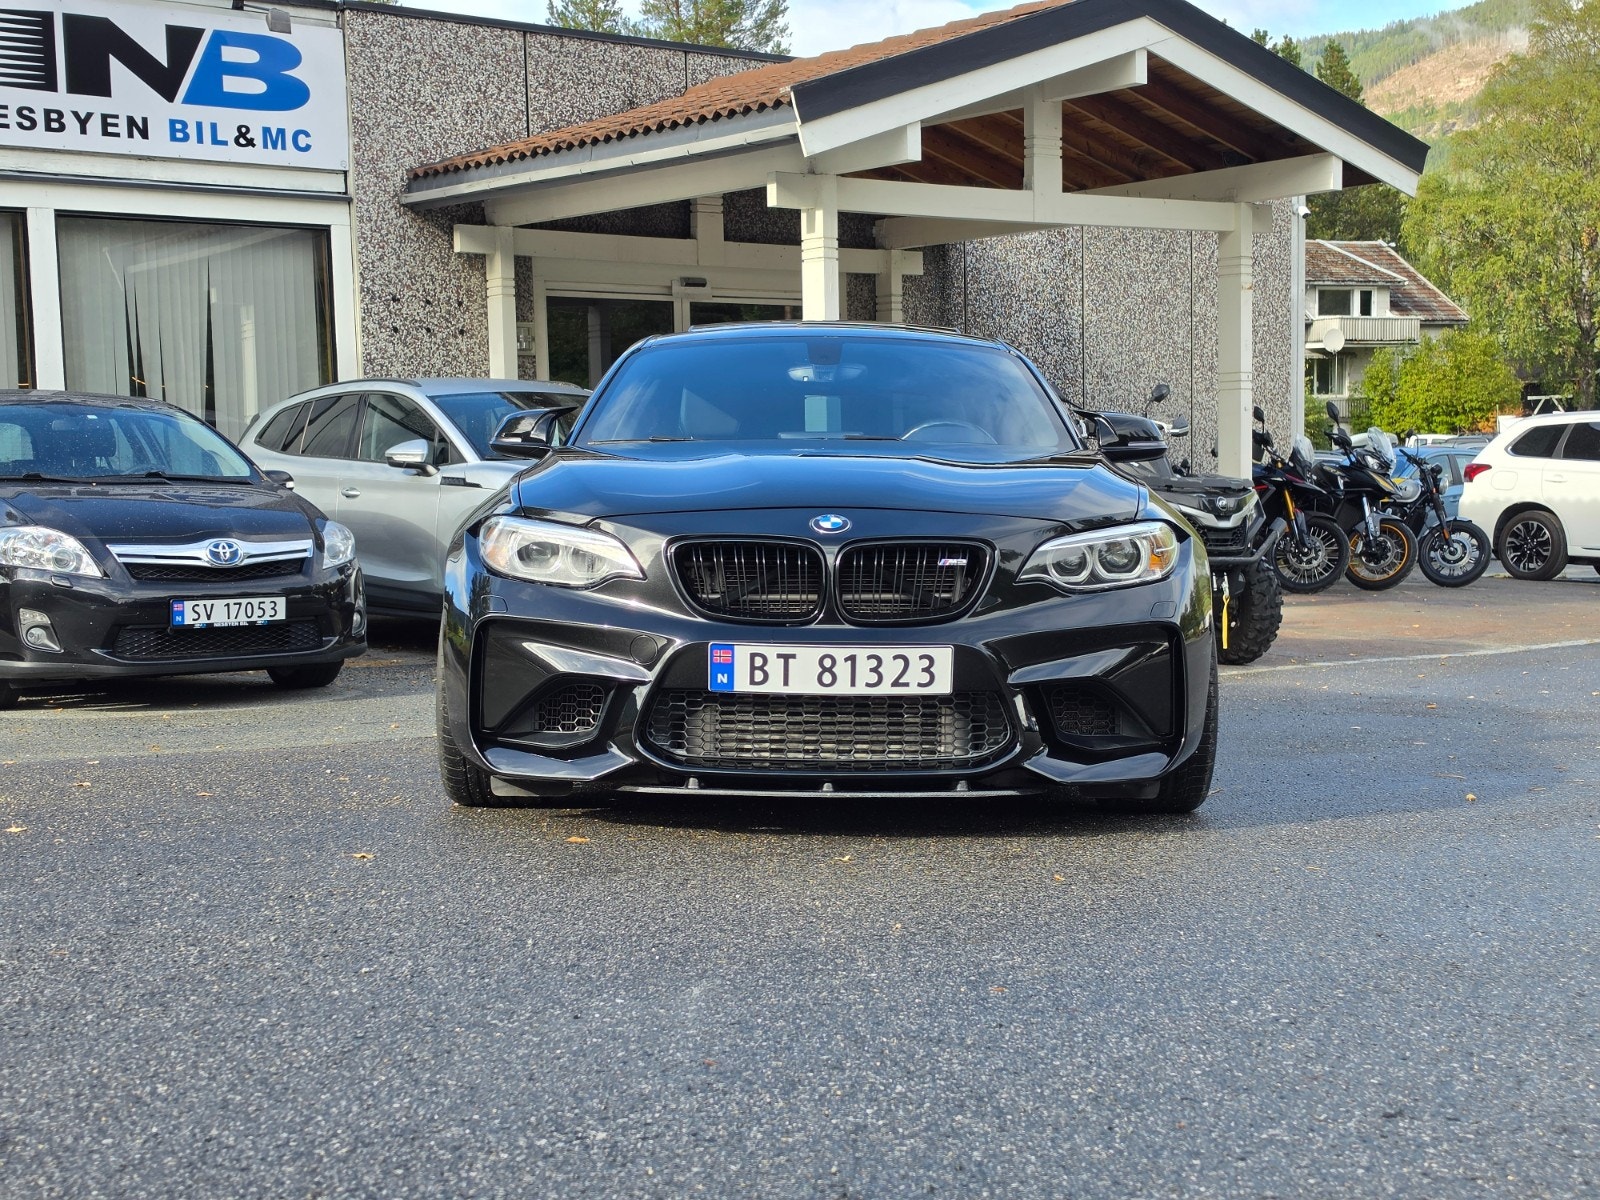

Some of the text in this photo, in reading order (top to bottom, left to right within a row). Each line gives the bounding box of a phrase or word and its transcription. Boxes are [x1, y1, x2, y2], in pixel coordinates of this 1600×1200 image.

[191, 600, 278, 622] SV 17053
[717, 673, 728, 684] N
[749, 652, 936, 688] BT 81323
